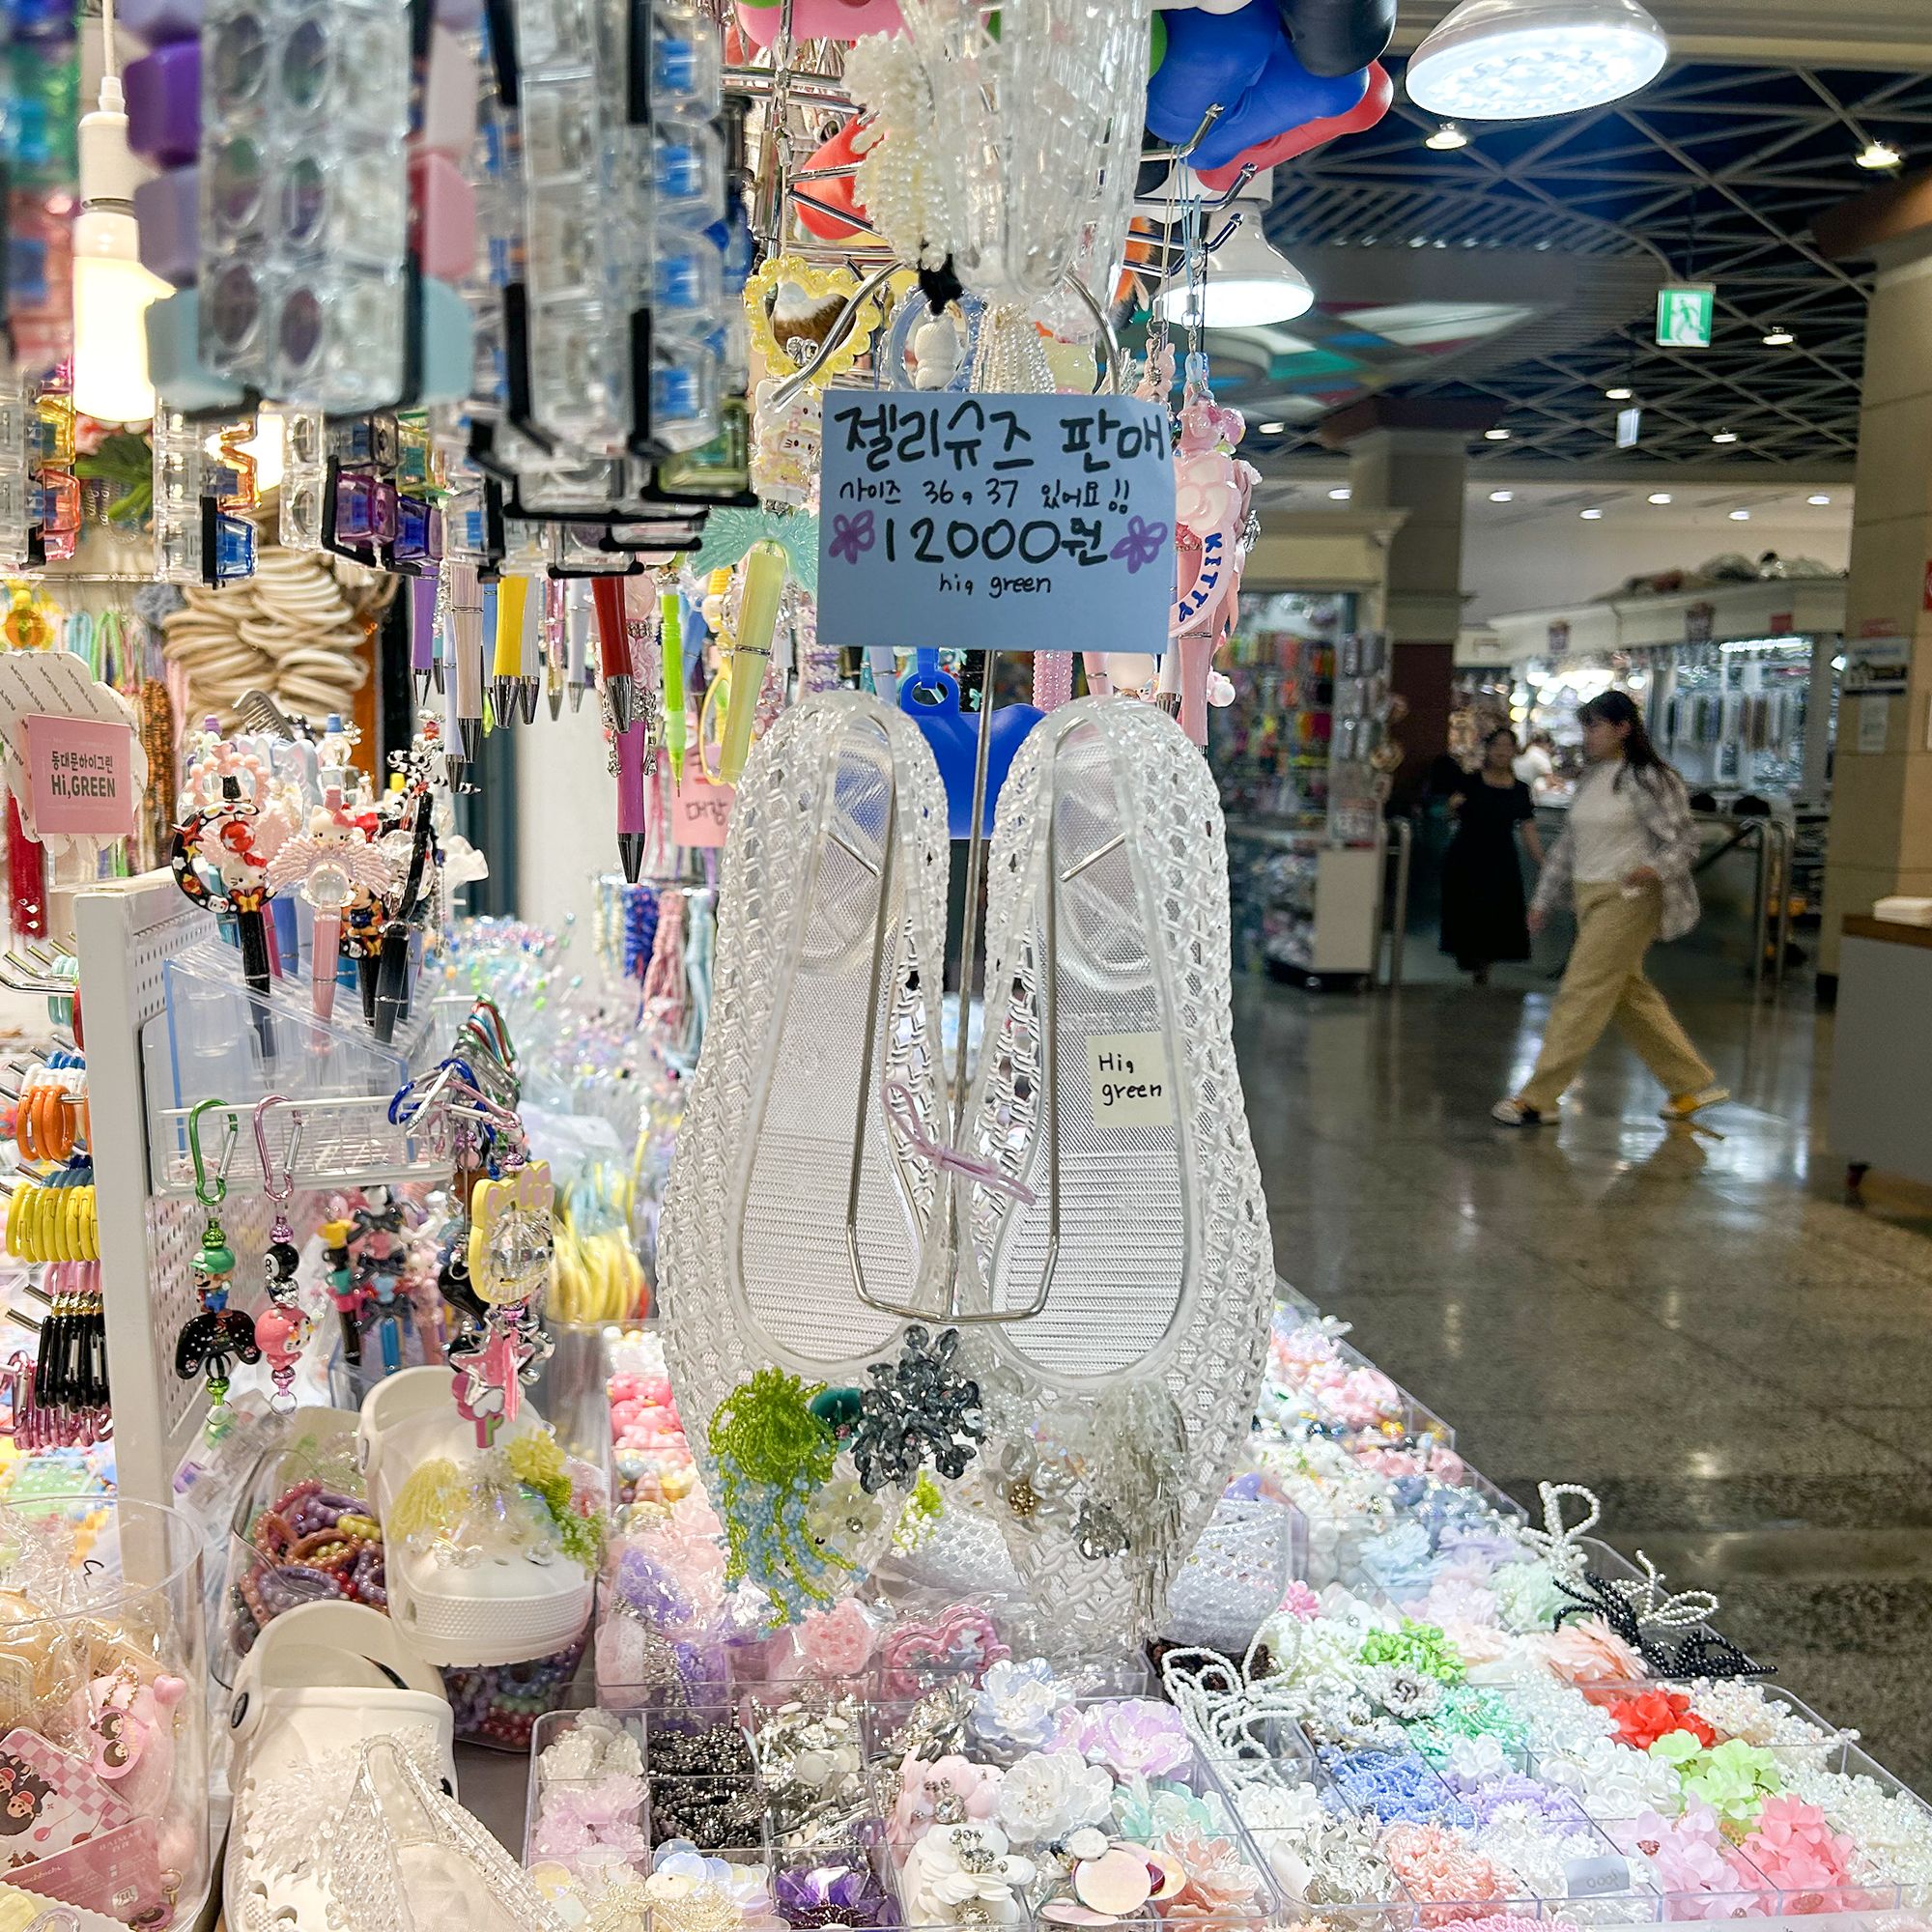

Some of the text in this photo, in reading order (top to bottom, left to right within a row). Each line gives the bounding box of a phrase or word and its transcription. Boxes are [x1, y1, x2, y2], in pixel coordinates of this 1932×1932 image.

[834, 400, 1035, 473] 젤리슈즈
[838, 479, 902, 504] 사이즈
[985, 478, 1020, 508] 37
[885, 517, 1109, 567] 12000원
[988, 576, 1053, 598] green
[1179, 532, 1223, 623] KITTY
[51, 750, 114, 774] 동대문하이그린
[51, 774, 116, 800] Hi,GREEN
[1101, 1083, 1163, 1107] green
[265, 1258, 273, 1274] 8
